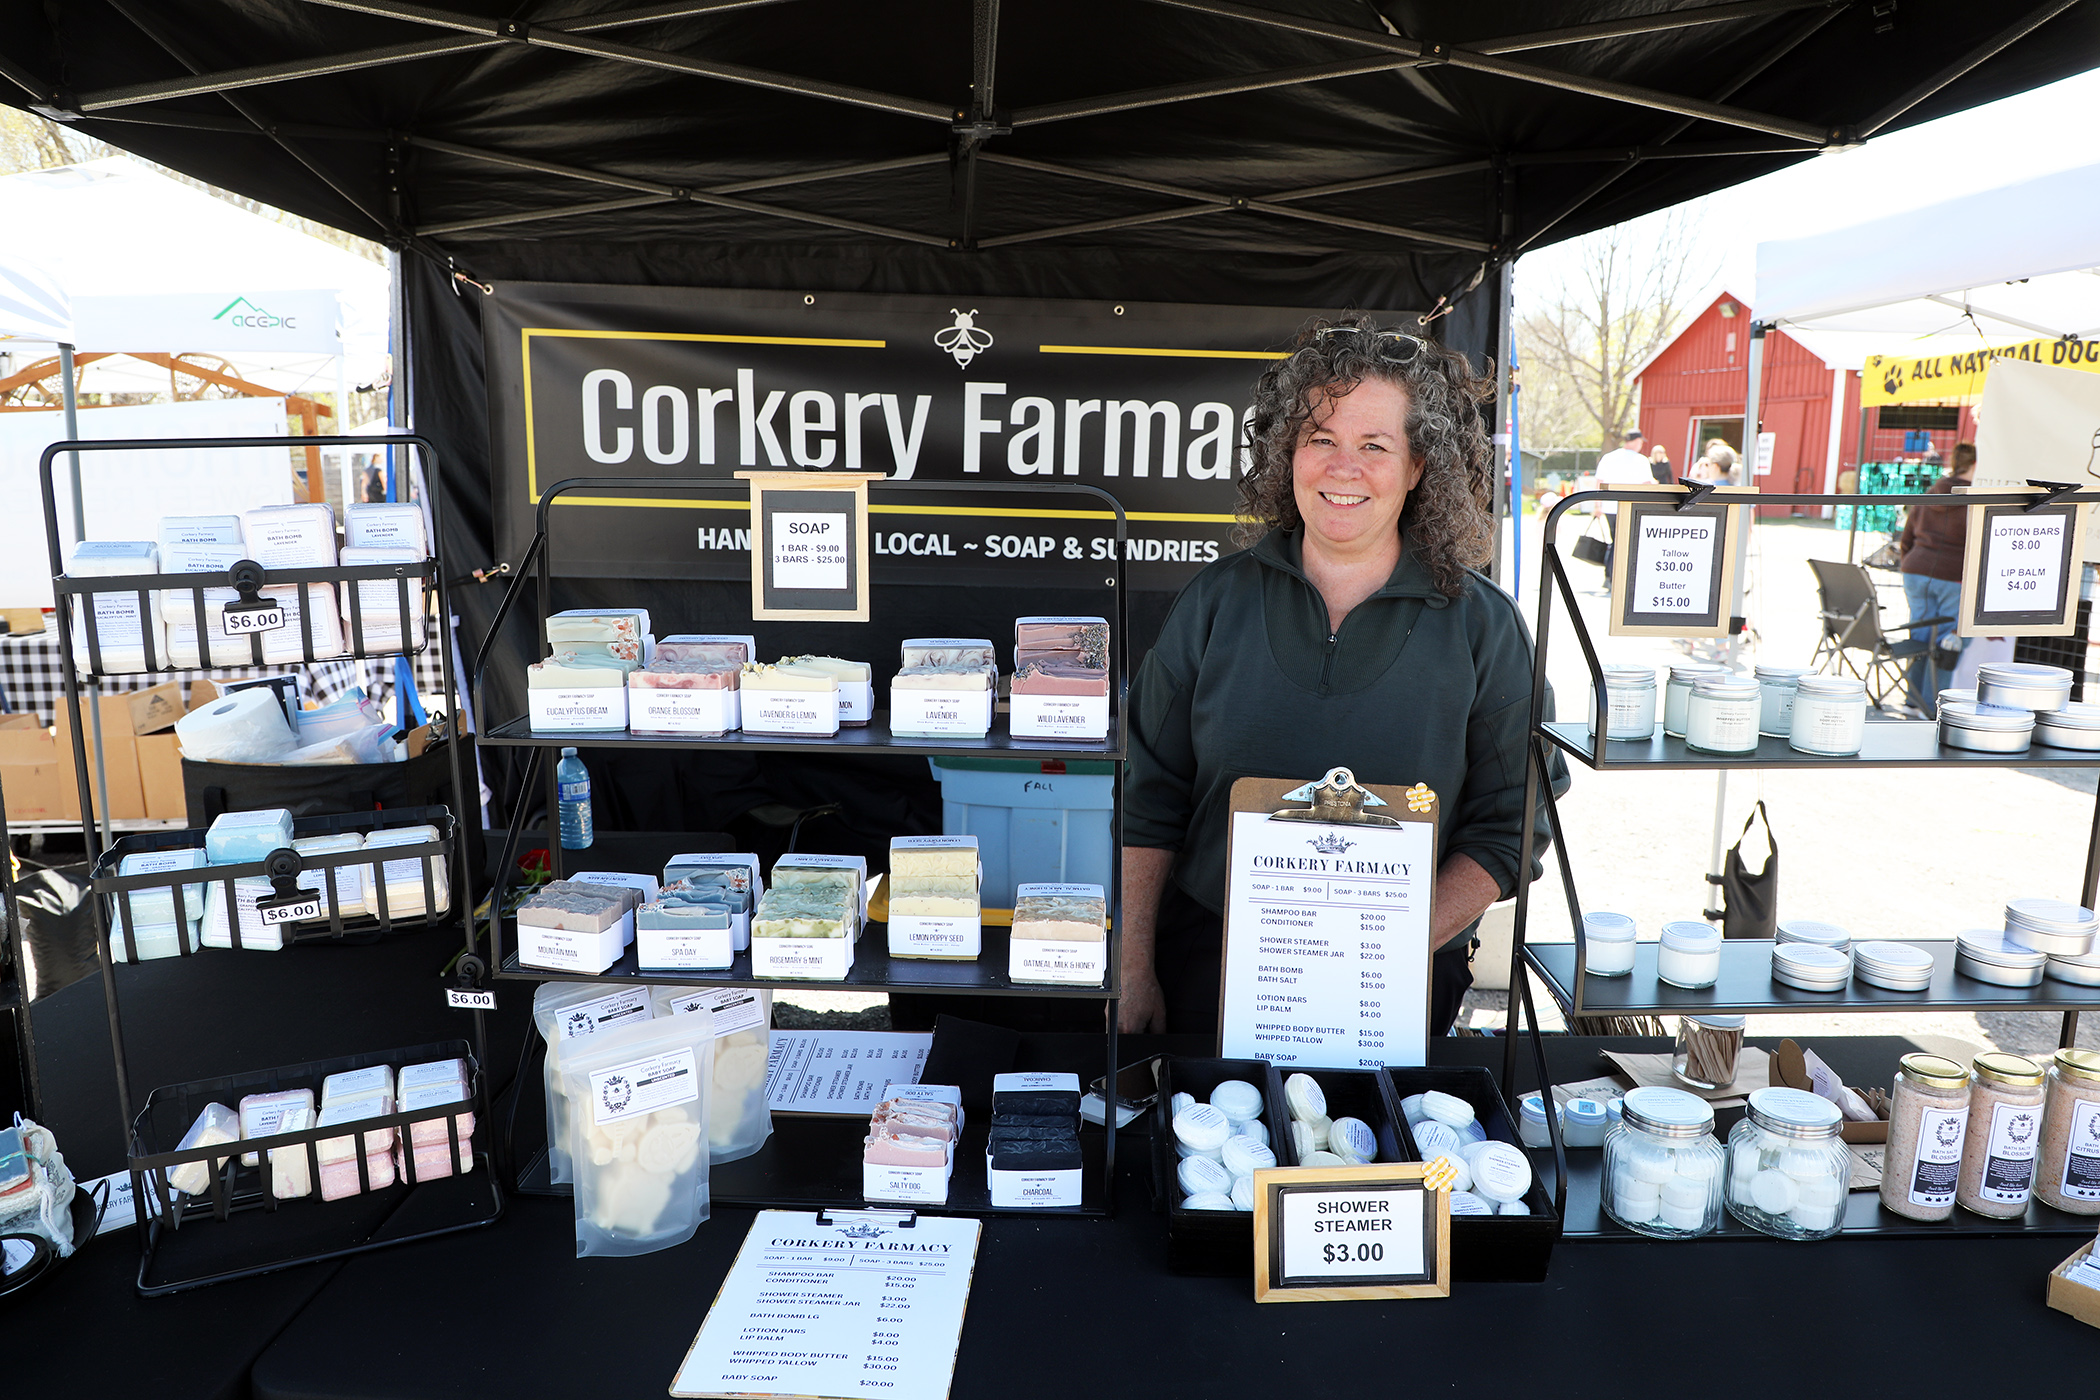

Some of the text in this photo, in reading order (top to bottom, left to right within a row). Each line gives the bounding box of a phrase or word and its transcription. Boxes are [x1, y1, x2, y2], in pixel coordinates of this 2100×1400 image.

[1912, 359, 1942, 380] ALL
[2052, 340, 2099, 364] DOG
[582, 367, 932, 480] Corkery
[789, 522, 830, 534] SOAP
[1646, 528, 1708, 539] WHIPPED
[1994, 528, 2030, 536] LOTION
[788, 544, 808, 552] BAR
[816, 544, 839, 552] $9.00
[875, 532, 956, 556] LOCAL
[984, 535, 1055, 559] SOAP
[1062, 538, 1083, 560] &
[2011, 540, 2040, 550] $8.00
[1662, 549, 1689, 558] Tallow
[817, 556, 845, 564] $25.00
[1655, 561, 1693, 572] $30.00
[2001, 568, 2046, 577] LIP BALM
[1660, 582, 1686, 590] Butter
[2007, 581, 2036, 590] $4.00
[1652, 597, 1690, 607] $15.00
[230, 613, 278, 630] $6.00
[673, 707, 701, 715] BLOSSOM
[760, 710, 790, 718] LAVENDER
[926, 711, 957, 720] LAVENDER
[1038, 715, 1086, 724] WILD LAVENDER
[1253, 855, 1412, 876] CORKERY FARMACY
[1252, 883, 1271, 891] SOAP
[1303, 886, 1322, 894] $9.00
[1334, 888, 1352, 896] SOAP
[1385, 891, 1407, 899] $25.00
[267, 905, 314, 920] $6.00
[1261, 908, 1386, 921] SHAMPOO BAR $20.00
[1261, 918, 1385, 932] CONDITIONER $15.00
[909, 934, 963, 942] LEMON POPPY SEED
[1260, 936, 1381, 950] SHOWER STEAMER $3.00
[538, 945, 578, 958] MOUNTAIN MAN
[672, 948, 697, 956] SPA DAY
[1259, 946, 1292, 955] SHOWER
[1293, 948, 1328, 957] STEAMER
[1360, 953, 1385, 961] $22.00
[770, 956, 801, 964] ROSEMARY
[1024, 959, 1095, 970] OATMEAL, MILK & HONEY
[1258, 965, 1279, 973] BATH
[1361, 971, 1382, 979] $6.00
[1258, 975, 1278, 983] BATH
[1360, 982, 1385, 990] $15.00
[451, 993, 490, 1005] $6.00
[1257, 994, 1286, 1002] LOTION
[1287, 996, 1307, 1004] BARS
[1269, 1005, 1292, 1013] BALM
[1360, 1011, 1381, 1019] $4.00
[1256, 1023, 1384, 1038] WHIPPED BODY BUTTER $15.00
[1255, 1033, 1384, 1048] WHIPPED TALLOW $30.00
[1254, 1052, 1385, 1067] BABY SOAP $20.00
[640, 1059, 681, 1073] Corkery Farmacy
[2076, 1146, 2099, 1154] CITRUS
[889, 1181, 921, 1190] SALTY DOG
[1022, 1188, 1053, 1196] CHARCOAL
[1317, 1200, 1390, 1215] SHOWER
[1313, 1219, 1392, 1233] STEAMER
[771, 1238, 953, 1253] CORKERY FARMACY
[1323, 1242, 1385, 1264] $3.00
[810, 1352, 849, 1360] BUTTER
[866, 1355, 899, 1363] $15.00
[729, 1358, 897, 1371] WHIPPED TALLOW $30.00
[859, 1380, 894, 1388] $20.00
